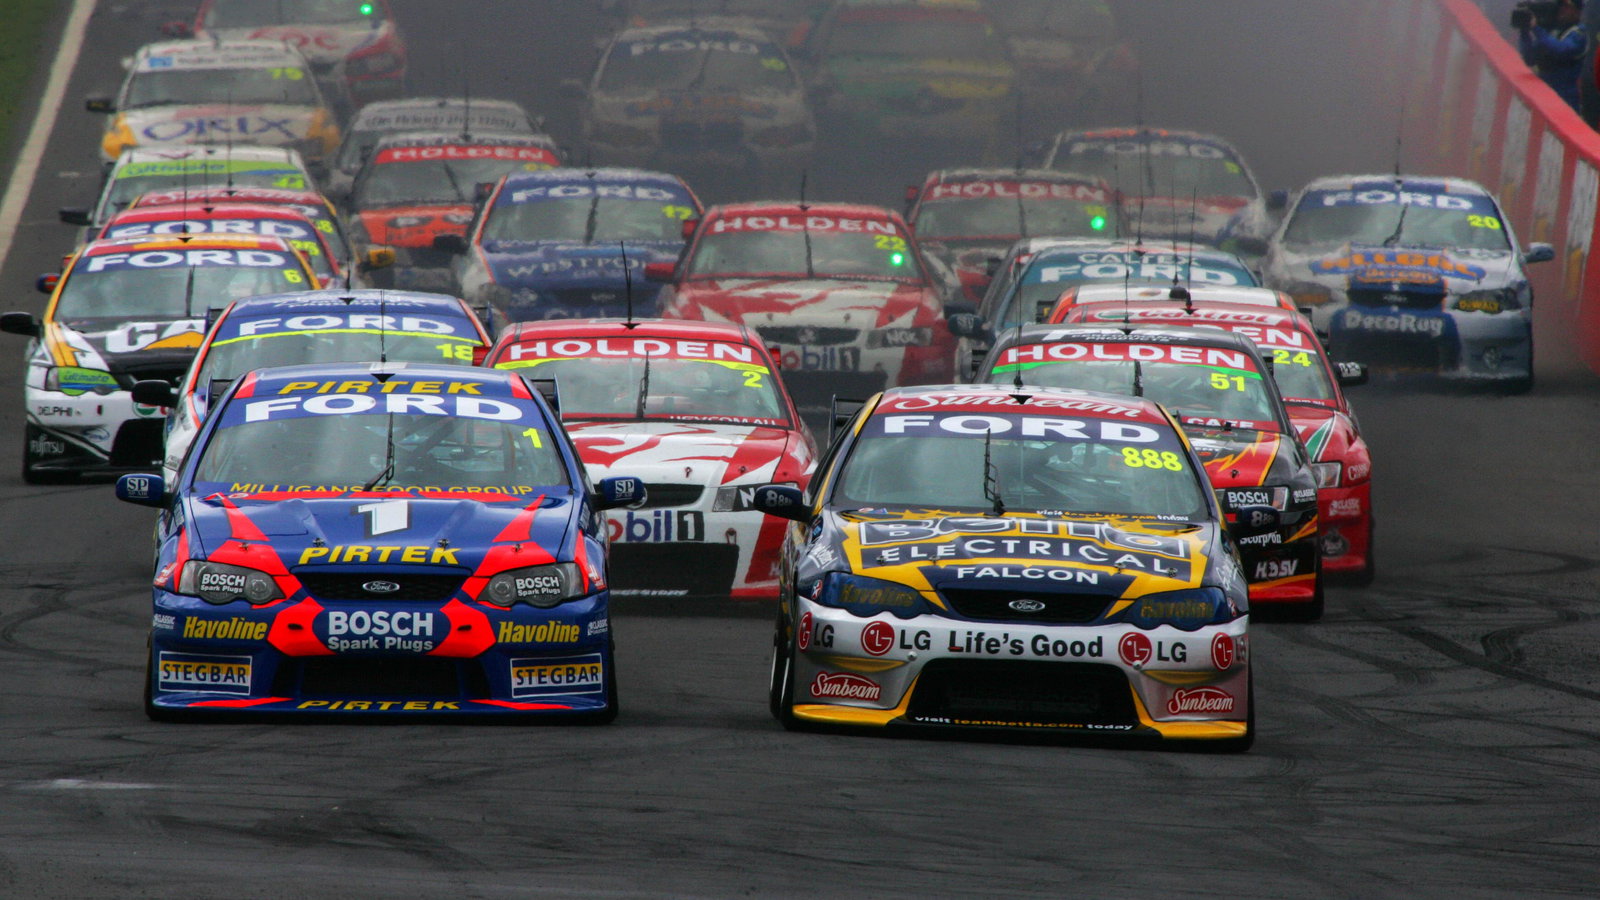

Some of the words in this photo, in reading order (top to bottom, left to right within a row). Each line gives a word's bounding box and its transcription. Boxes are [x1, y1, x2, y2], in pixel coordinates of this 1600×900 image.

[143, 116, 300, 141] ORIX
[393, 147, 543, 160] HOLDEN
[1070, 142, 1224, 159] FORD
[512, 185, 675, 203] FORD
[932, 182, 1105, 201] HOLDEN
[1323, 189, 1473, 210] FORD
[112, 219, 308, 239] FORD
[714, 216, 896, 235] HOLDEN
[1467, 214, 1501, 230] 20
[874, 234, 907, 252] 22
[87, 249, 286, 272] FORD
[1078, 253, 1202, 267] CALTEX
[283, 268, 302, 283] 6
[1040, 263, 1237, 286] FORD
[239, 314, 455, 336] FORD
[1344, 310, 1443, 336] DecoRug
[436, 342, 474, 361] 18
[510, 339, 753, 362] HOLDEN
[777, 346, 836, 371] obil
[1009, 343, 1245, 369] HOLDEN
[1273, 349, 1311, 367] 24
[277, 381, 486, 395] PIRTEK
[742, 371, 763, 388] 2
[1210, 372, 1245, 392] 51
[245, 393, 523, 423] FORD
[522, 428, 542, 449] 1
[884, 415, 1160, 443] FORD
[1121, 447, 1182, 472] 888
[127, 478, 148, 491] SP
[616, 479, 634, 493] SP
[1228, 491, 1269, 503] BOSCH
[355, 499, 409, 537] 1
[607, 510, 672, 543] obil
[298, 545, 461, 565] PIRTEK
[881, 538, 1172, 575] ELECTRICAL
[202, 573, 246, 587] BOSCH
[515, 576, 560, 589] BOSCH
[957, 567, 1098, 585] FALCON
[200, 584, 220, 592] Spark
[221, 585, 243, 593] Plugs
[518, 589, 540, 597] Spark
[541, 587, 561, 595] Plugs
[183, 616, 268, 641] Havoline
[328, 610, 434, 637] BOSCH
[497, 620, 580, 643] Havoline
[327, 636, 381, 654] Spark
[385, 636, 434, 654] Plugs
[813, 623, 835, 649] LG
[899, 629, 931, 650] LG
[948, 630, 1025, 656] Life's
[1030, 634, 1103, 658] Good
[1157, 640, 1187, 663] LG
[163, 663, 247, 684] STEGBAR
[516, 665, 599, 686] STEGBAR
[811, 673, 880, 700] Sunbeam
[296, 700, 461, 711] PIRTEK
[1168, 687, 1233, 715] Sunbeam
[915, 716, 951, 724] visit
[1087, 723, 1133, 732] today
